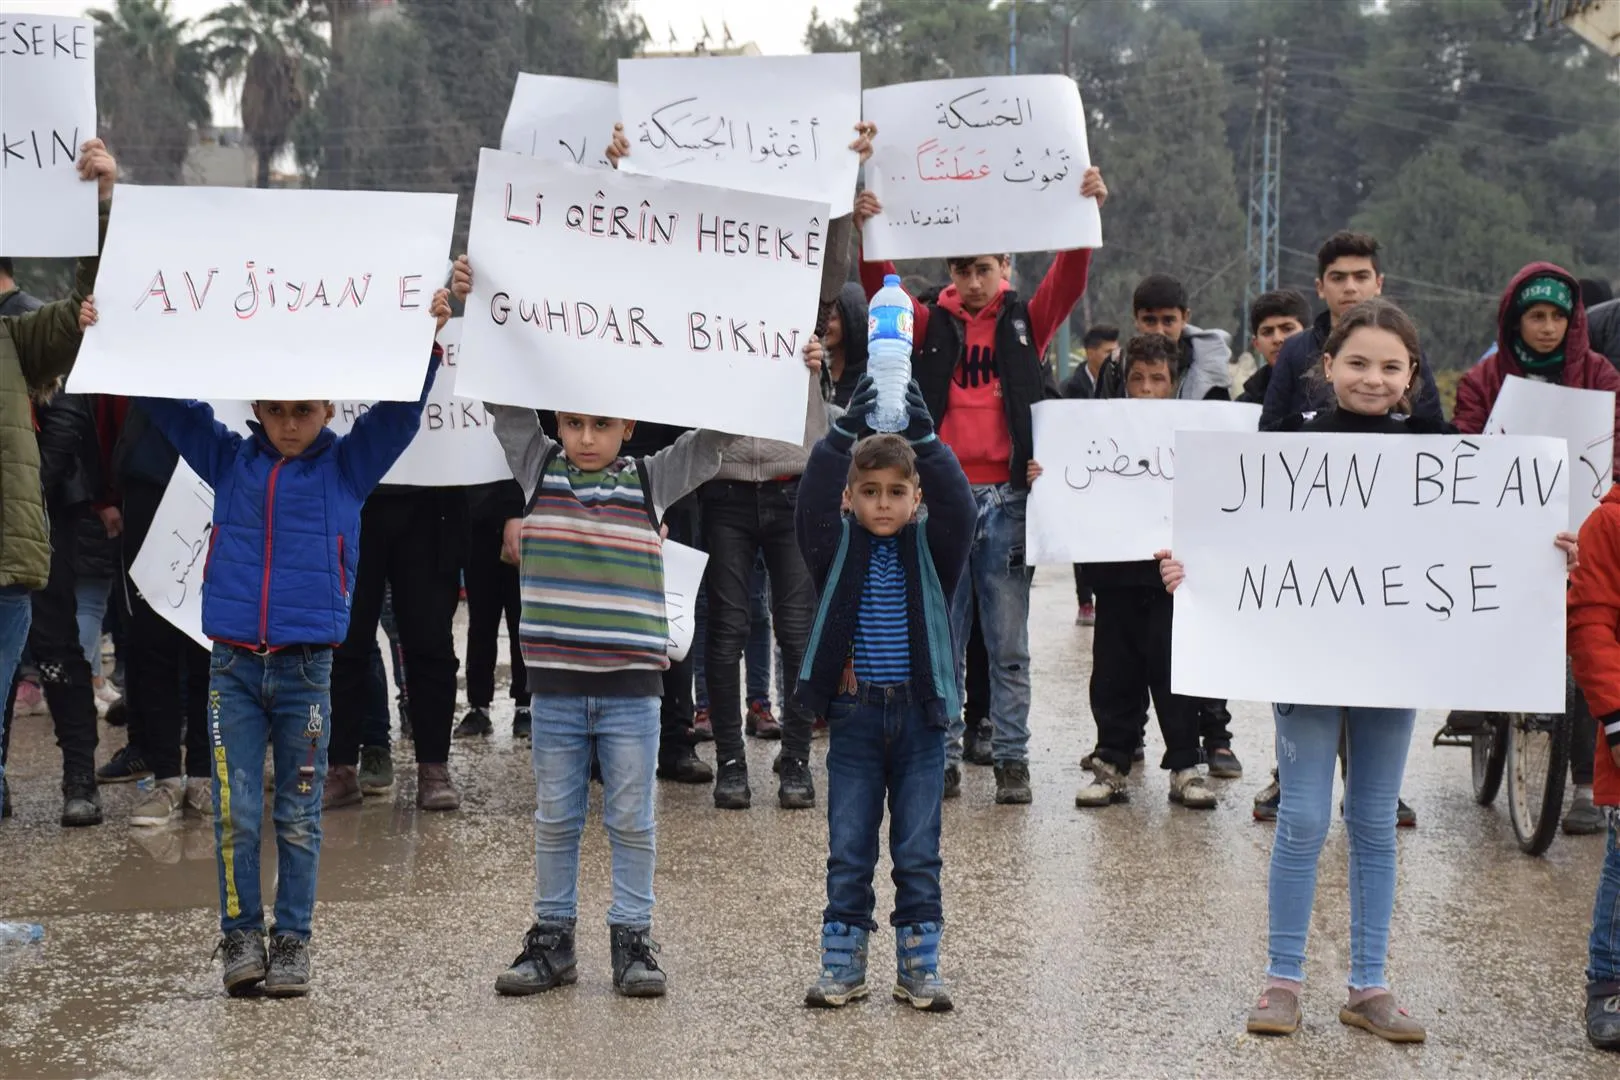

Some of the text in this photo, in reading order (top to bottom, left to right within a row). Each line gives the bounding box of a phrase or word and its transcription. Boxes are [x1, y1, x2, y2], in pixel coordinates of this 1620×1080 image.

[697, 213, 823, 268] HESEKÊ
[134, 269, 219, 315] AV
[1220, 439, 1563, 513] JIYAN BÊ AV
[1237, 558, 1501, 622] NAMEŞE
